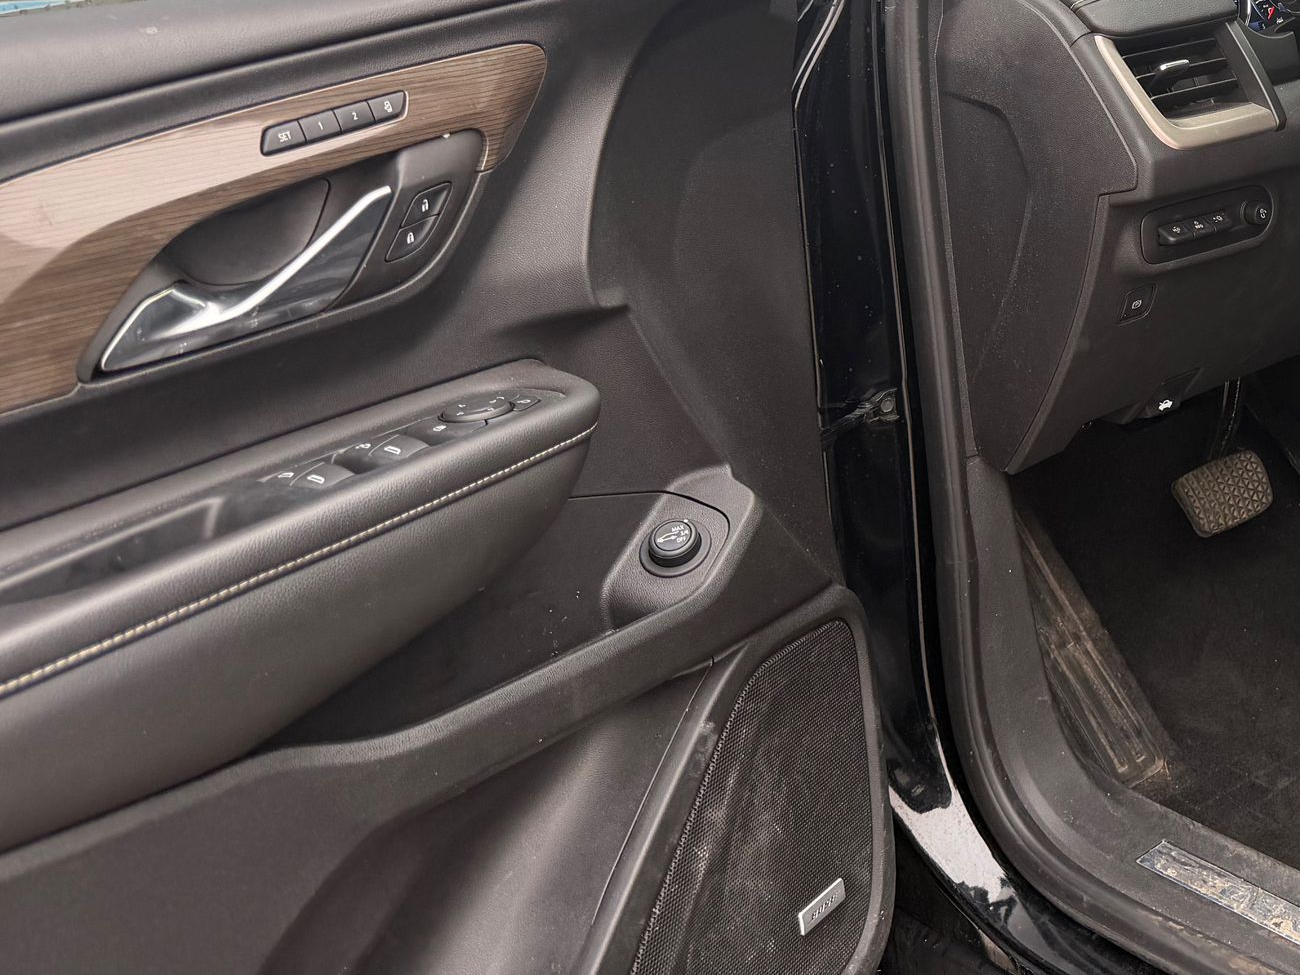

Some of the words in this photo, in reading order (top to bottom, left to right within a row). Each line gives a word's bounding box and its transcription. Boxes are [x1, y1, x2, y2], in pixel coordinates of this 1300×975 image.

[351, 111, 359, 121] 2
[318, 121, 324, 130] 1
[278, 130, 292, 143] SET
